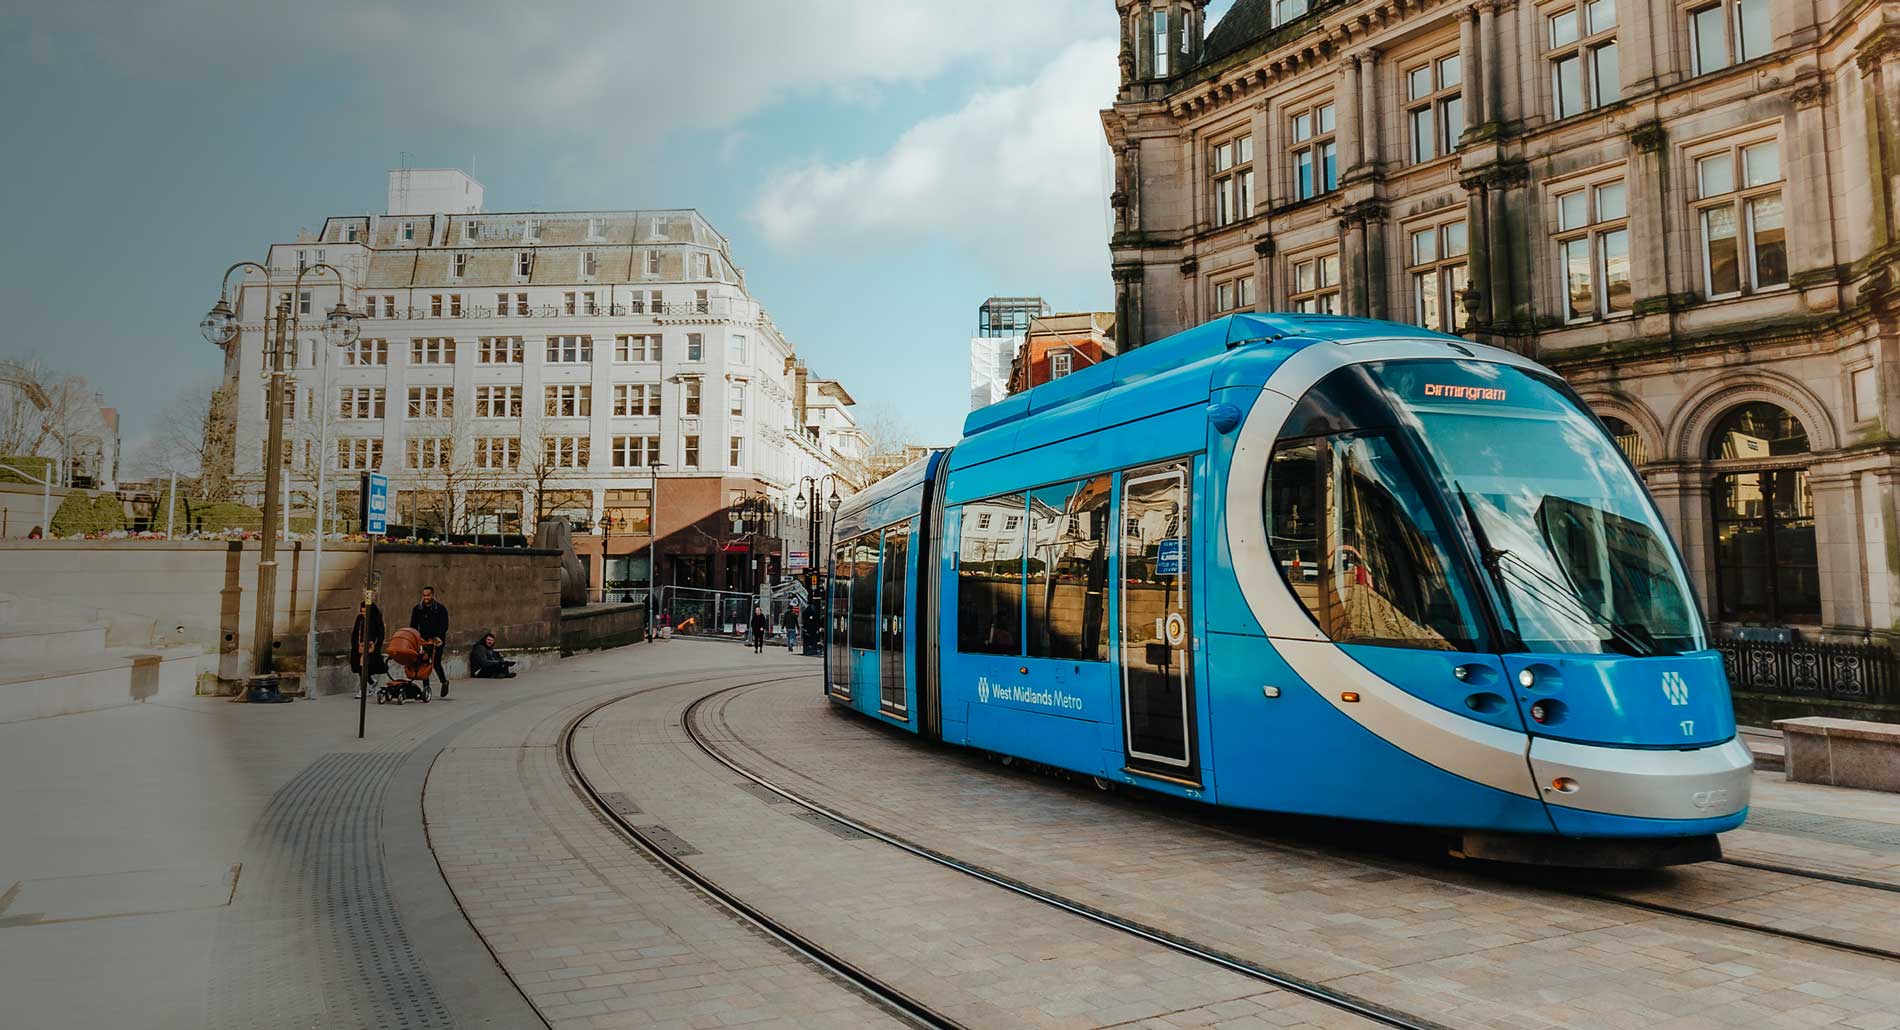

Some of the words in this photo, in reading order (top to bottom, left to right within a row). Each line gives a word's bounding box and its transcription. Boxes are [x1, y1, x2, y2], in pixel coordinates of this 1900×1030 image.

[992, 683, 1012, 700] West
[1013, 686, 1052, 706] Midlands
[1053, 690, 1083, 710] Metro
[1680, 720, 1695, 736] 17
